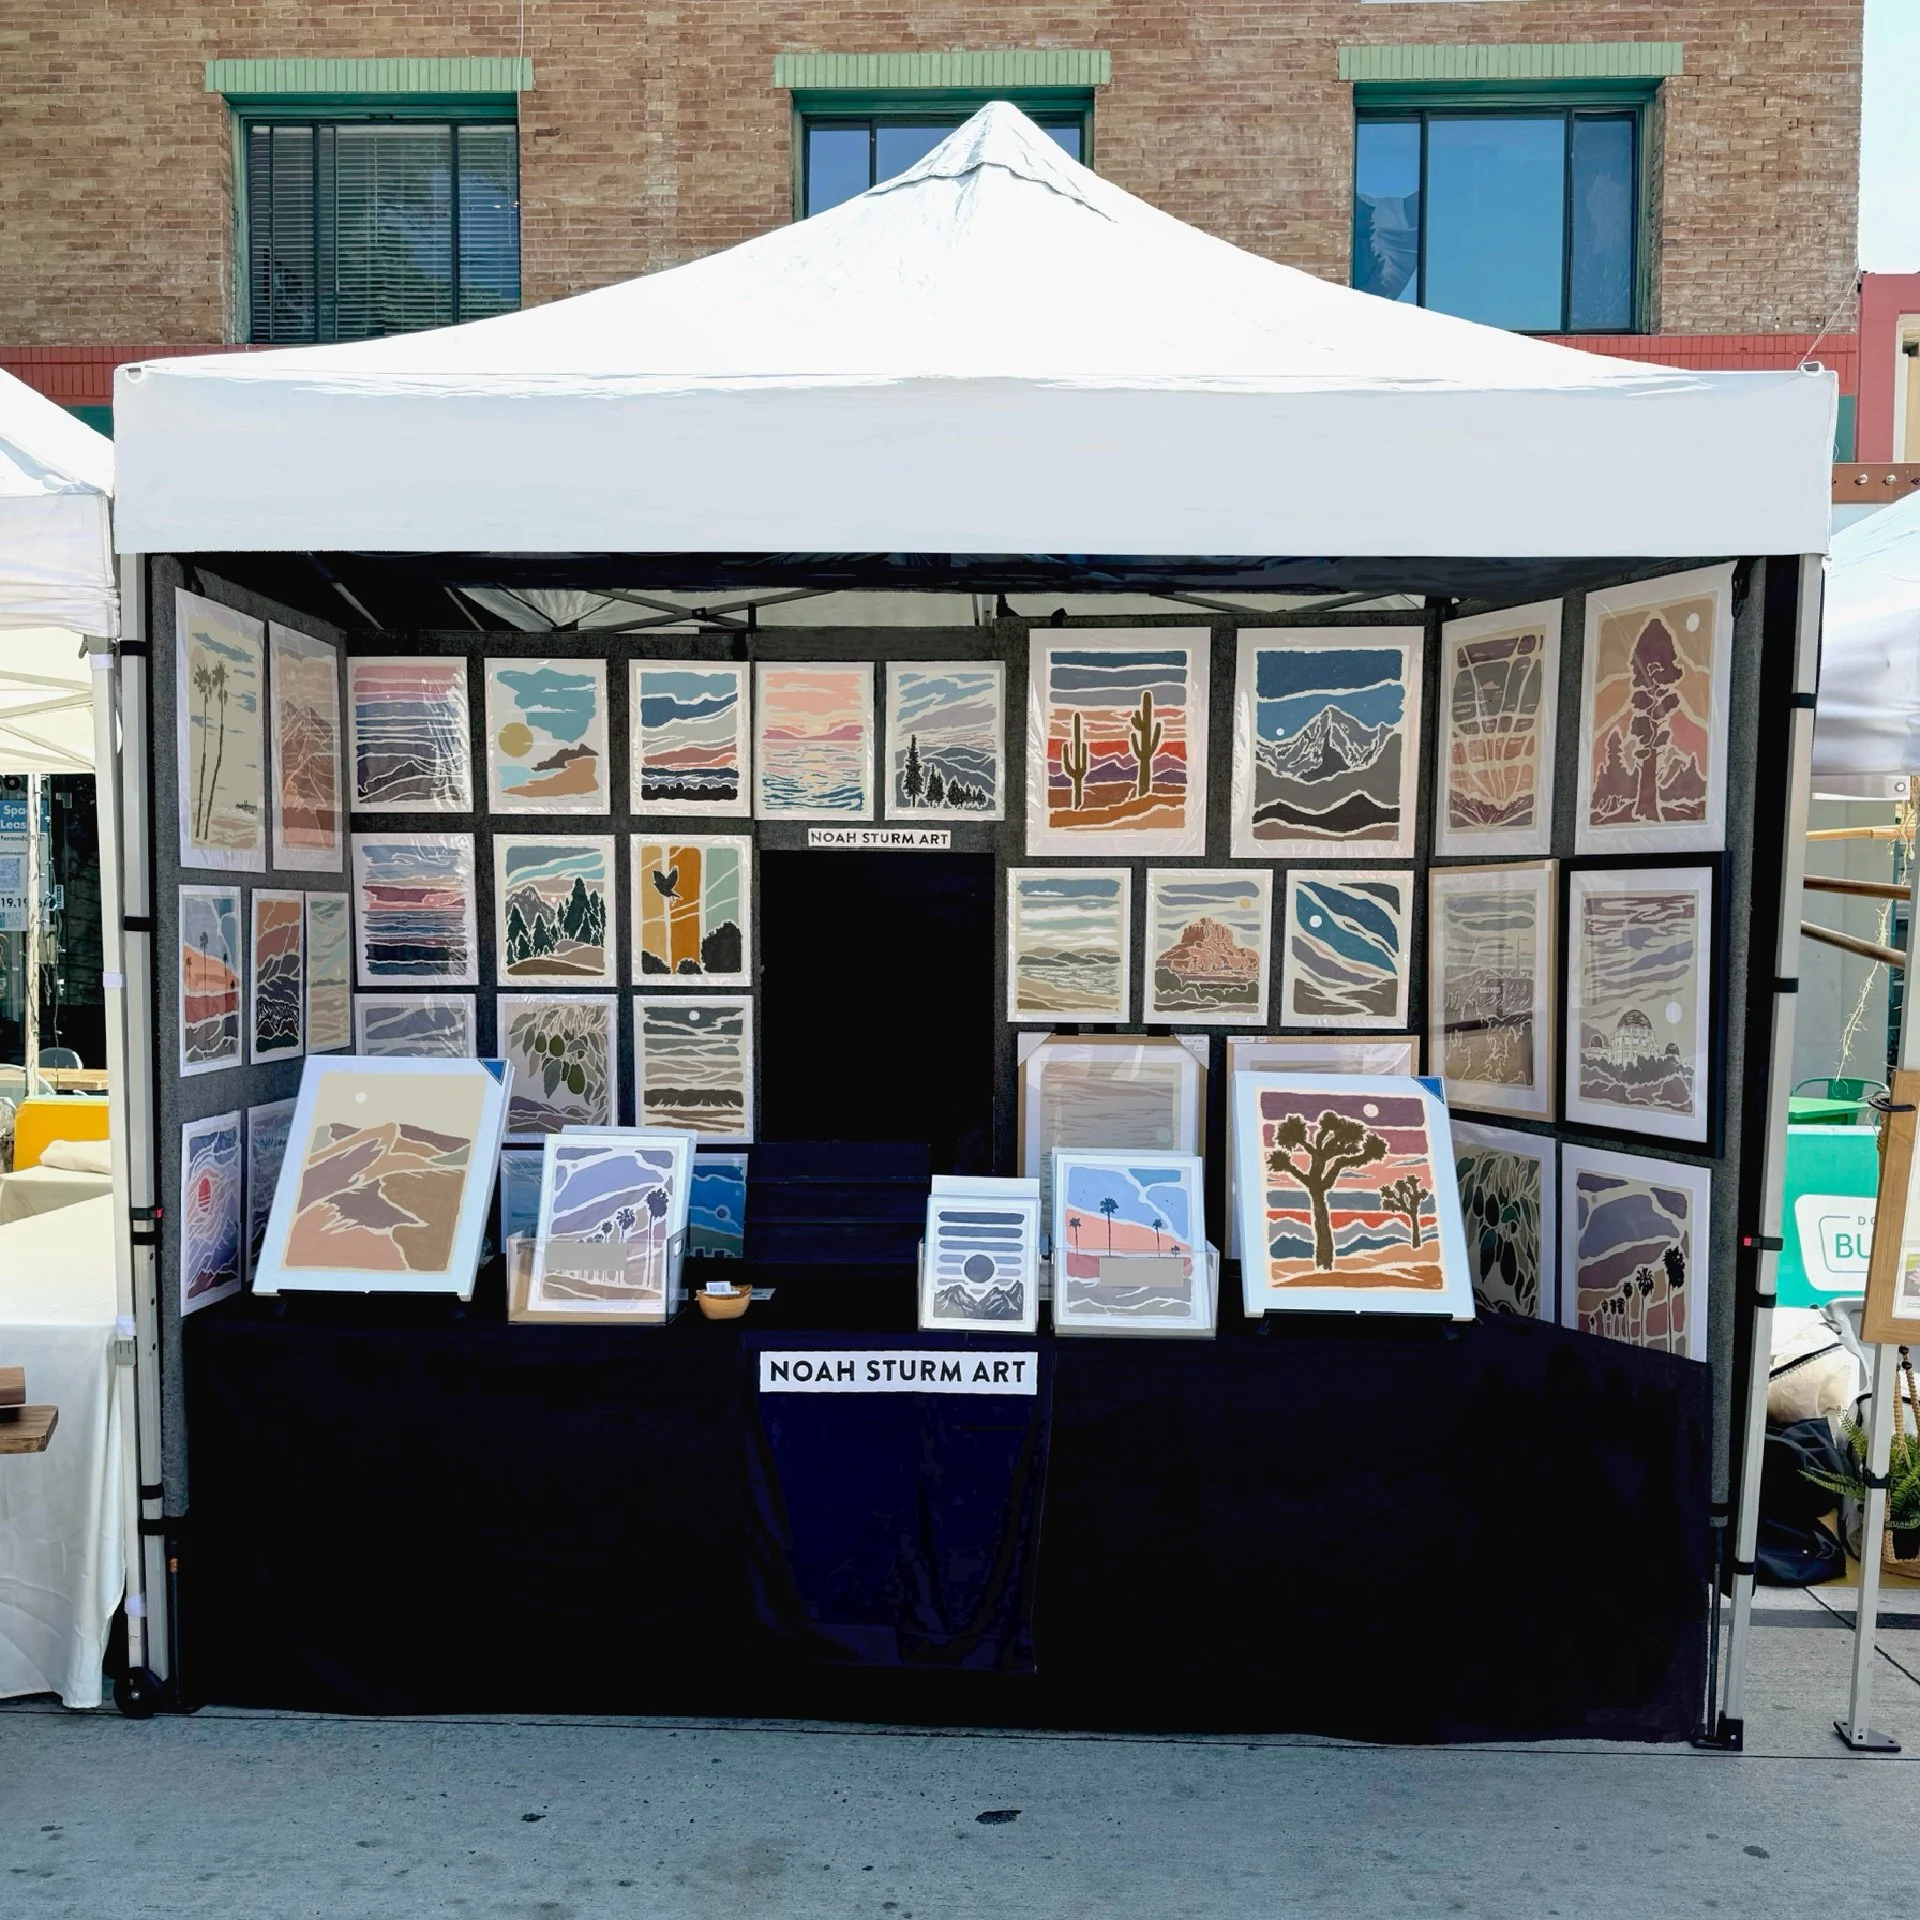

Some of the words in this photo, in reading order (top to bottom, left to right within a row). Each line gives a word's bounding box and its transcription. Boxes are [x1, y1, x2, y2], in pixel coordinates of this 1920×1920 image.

[0, 820, 29, 830] Leas
[811, 832, 857, 844] NOAH
[861, 832, 915, 845] STURM
[919, 834, 948, 845] ART
[770, 1360, 856, 1382] NOAH
[866, 1359, 963, 1383] STURM
[971, 1360, 1026, 1383] ART
